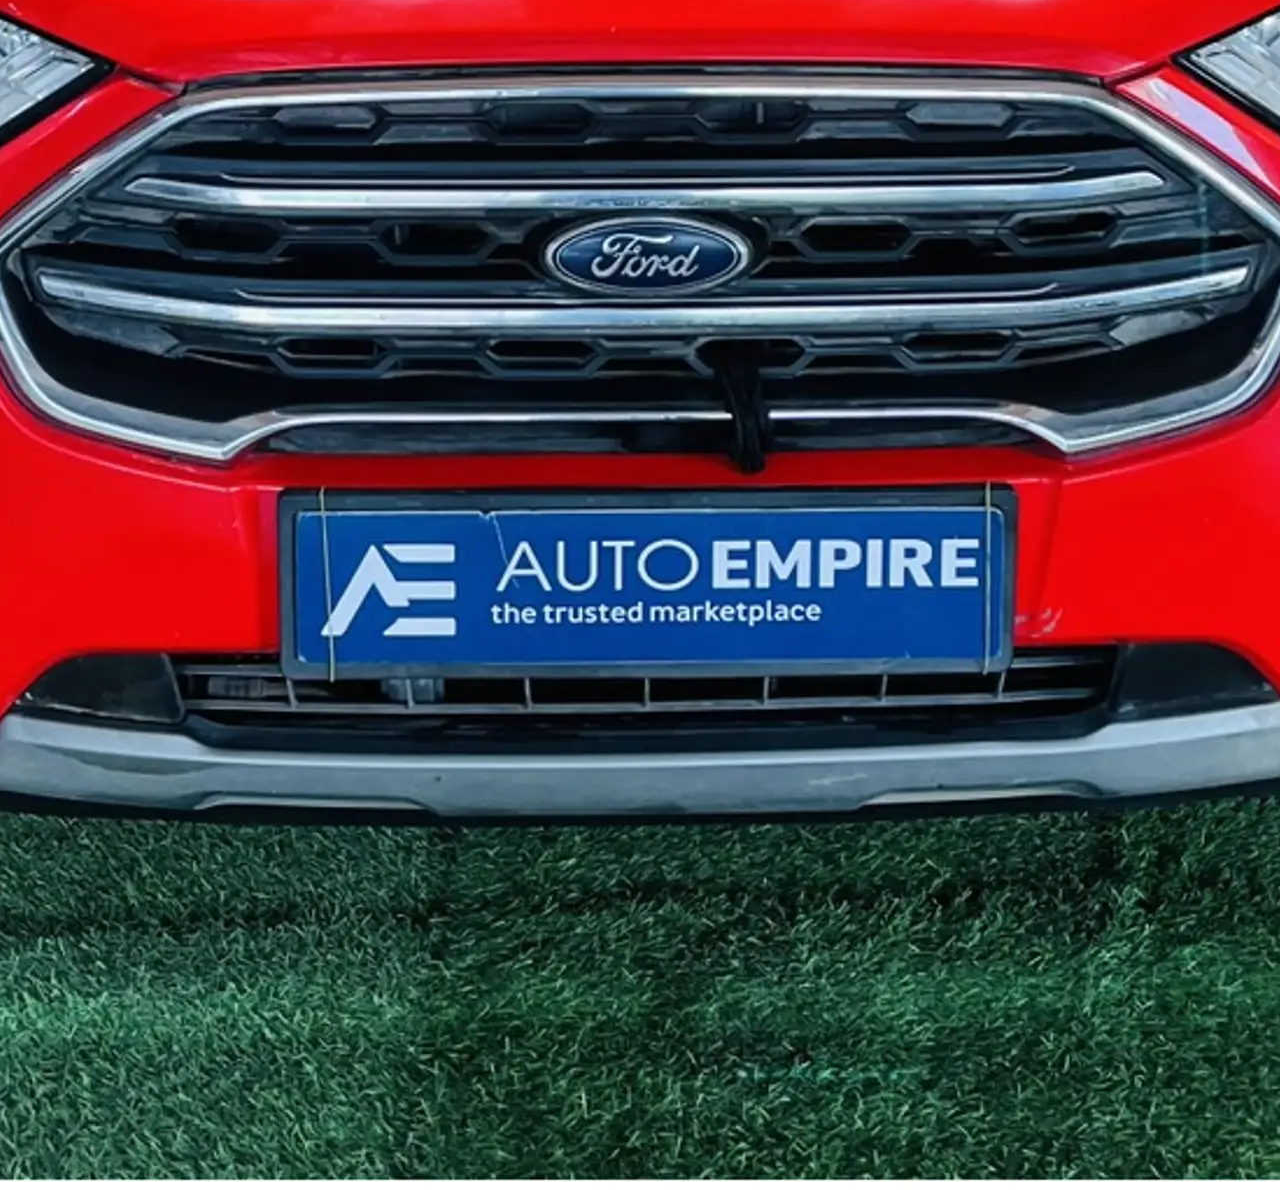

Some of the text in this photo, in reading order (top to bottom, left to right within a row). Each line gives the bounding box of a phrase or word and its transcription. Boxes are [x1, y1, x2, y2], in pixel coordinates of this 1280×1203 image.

[590, 232, 701, 278] Ford
[495, 537, 981, 593] AUTO EMPIRE
[490, 599, 823, 628] the trusted marketplace
